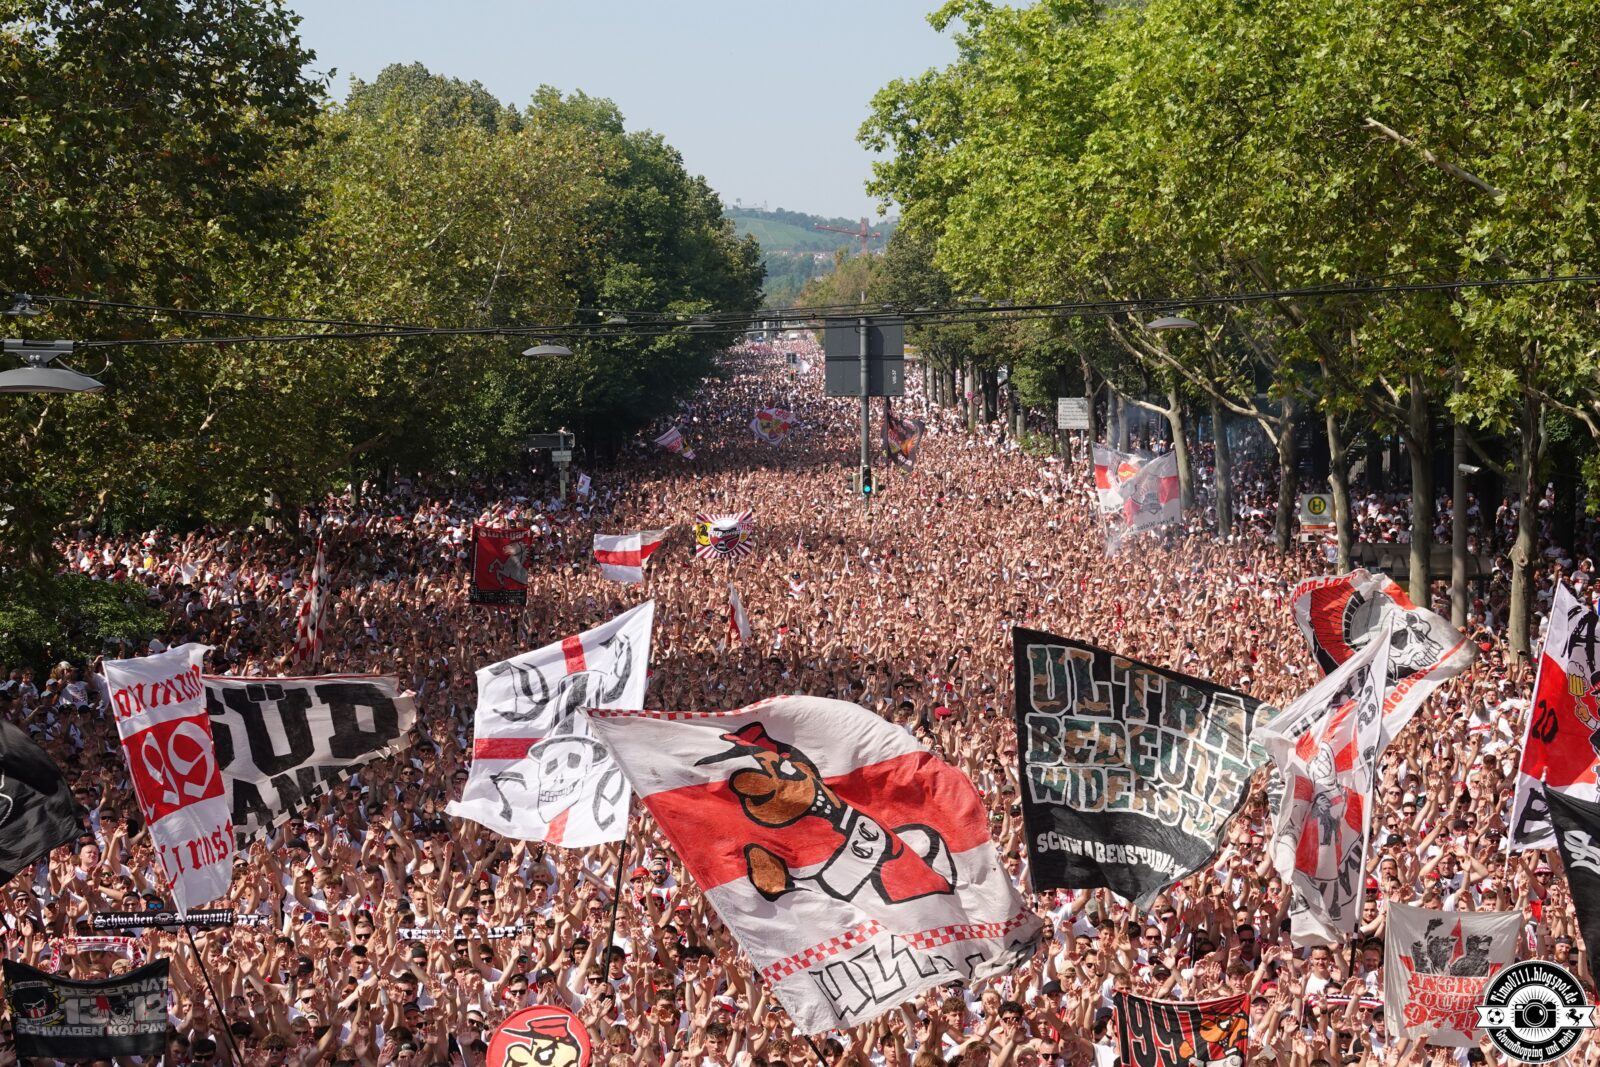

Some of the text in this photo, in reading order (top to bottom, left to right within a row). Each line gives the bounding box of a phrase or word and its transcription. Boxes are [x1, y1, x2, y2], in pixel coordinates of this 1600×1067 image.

[1531, 699, 1559, 745] 20
[94, 913, 154, 929] Schwaben
[60, 976, 169, 996] DEZERNAT
[17, 1023, 104, 1036] SCHWABEN
